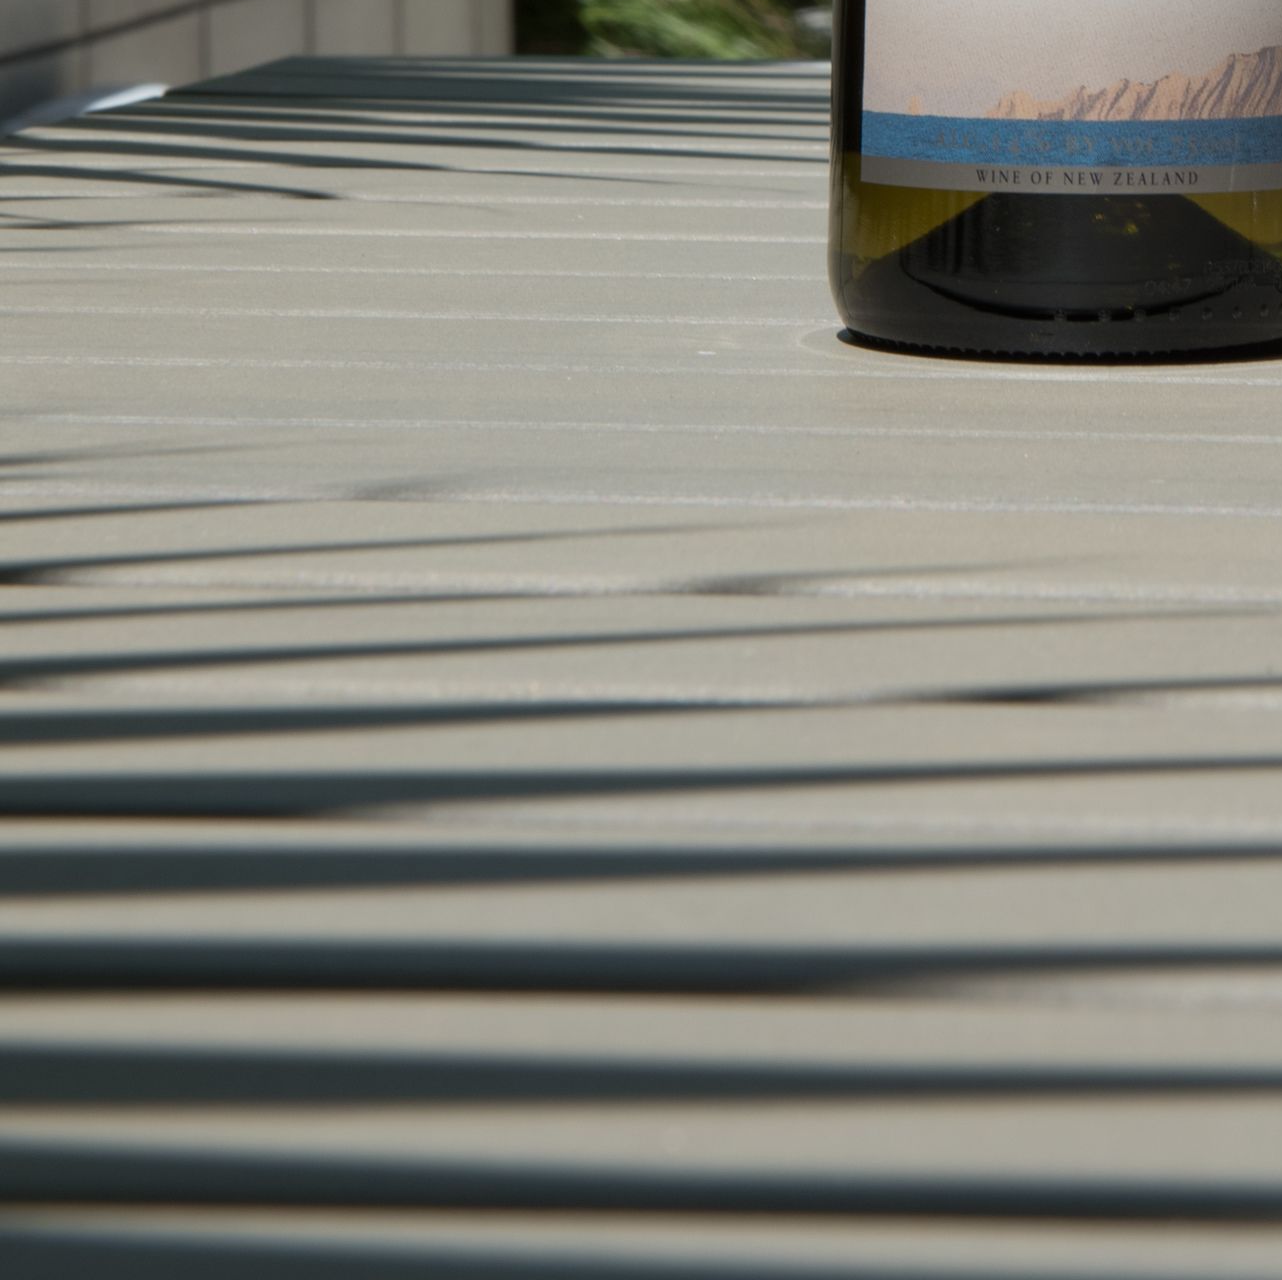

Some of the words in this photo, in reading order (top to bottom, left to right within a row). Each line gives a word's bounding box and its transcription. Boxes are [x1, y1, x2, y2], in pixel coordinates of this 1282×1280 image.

[976, 168, 1021, 185] WINE
[1030, 170, 1053, 185] OF
[1063, 171, 1104, 186] NEW
[1113, 170, 1199, 186] ZEALAND
